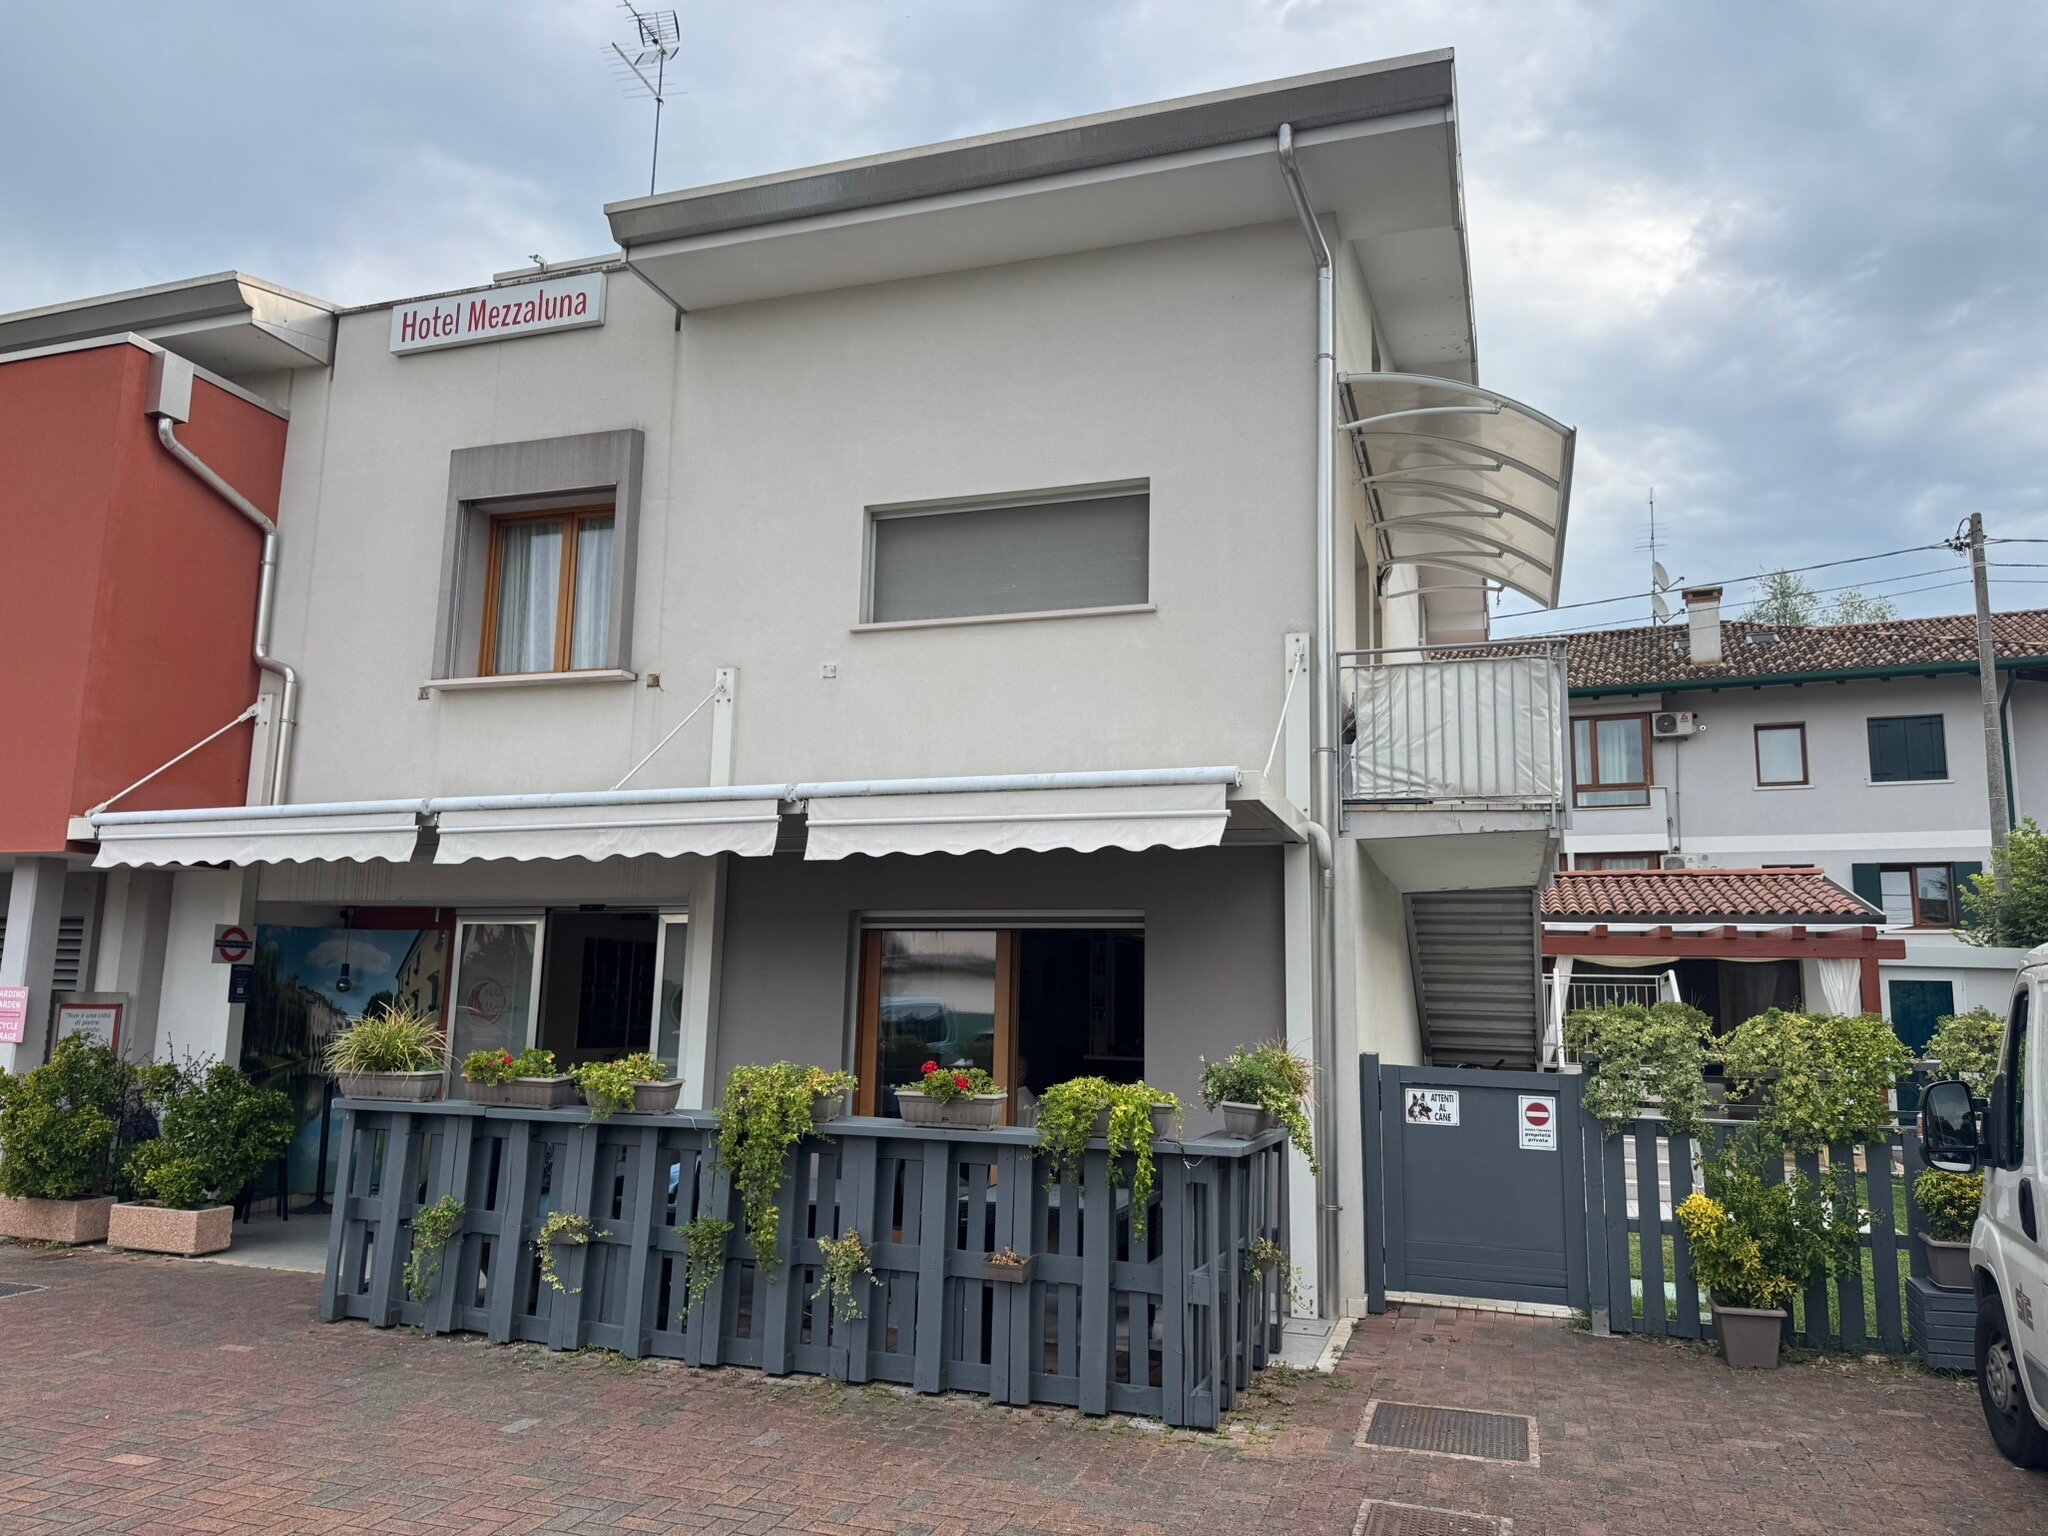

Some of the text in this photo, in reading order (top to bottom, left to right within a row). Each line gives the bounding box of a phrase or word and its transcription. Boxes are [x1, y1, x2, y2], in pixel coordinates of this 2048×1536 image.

[401, 289, 587, 343] Hotel Mezzaluna
[1431, 1093, 1454, 1103] ATTENTI
[1438, 1103, 1447, 1112] AL
[1434, 1112, 1451, 1121] CANE
